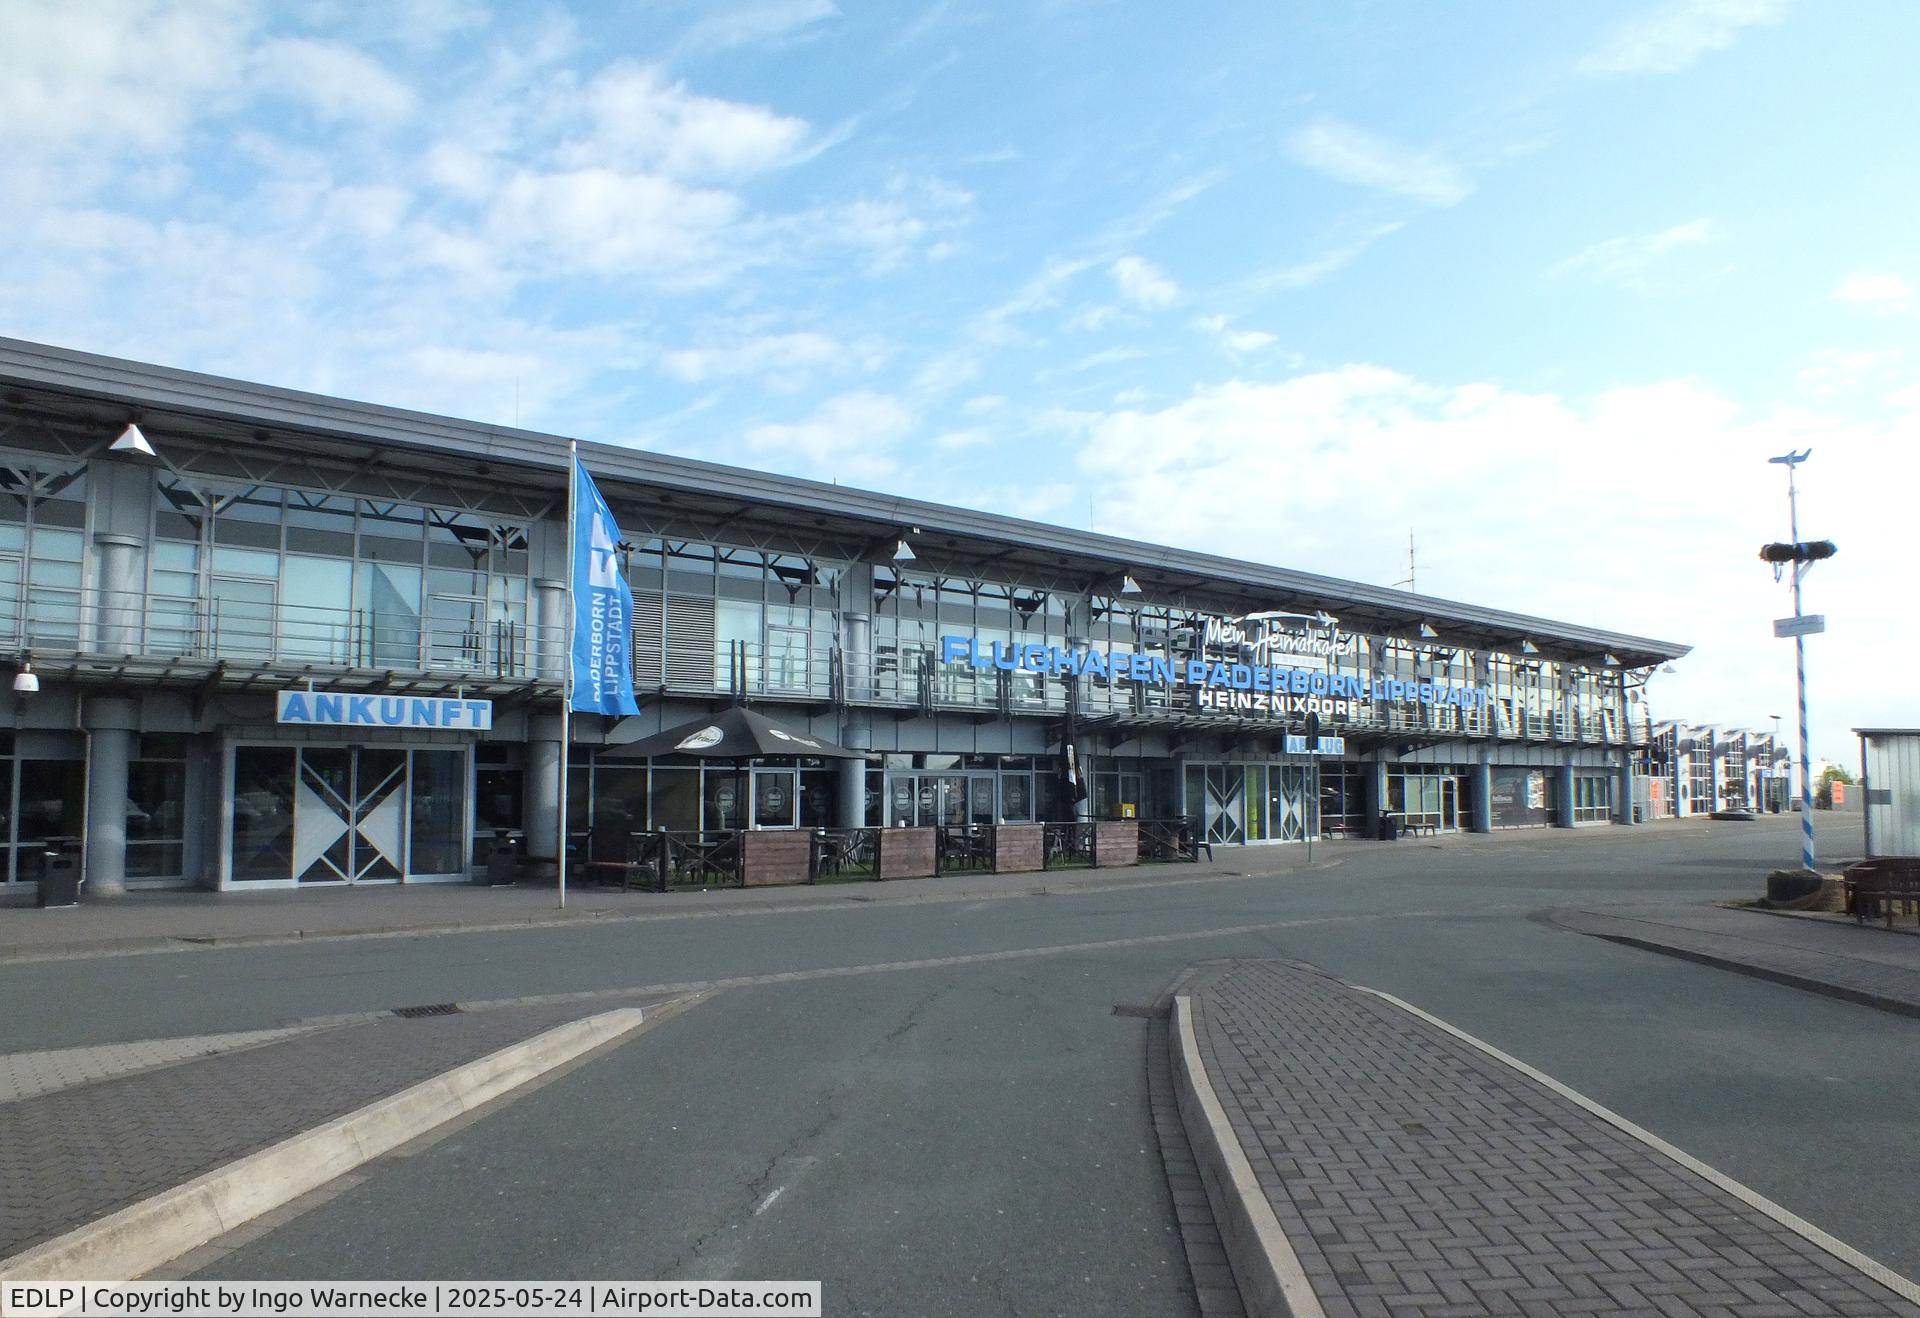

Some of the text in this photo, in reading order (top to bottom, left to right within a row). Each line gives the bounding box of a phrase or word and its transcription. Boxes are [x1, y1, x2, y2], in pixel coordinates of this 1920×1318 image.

[603, 595, 623, 695] LIPPSTADT
[1204, 616, 1355, 664] Mein Heimathafen
[942, 635, 1487, 707] FLUGHAFEN PADERBORN LIPPSTADT
[282, 693, 488, 727] ANKUNFT
[1199, 689, 1358, 716] HEINZ NIXDORF
[1289, 736, 1344, 753] ABLUG
